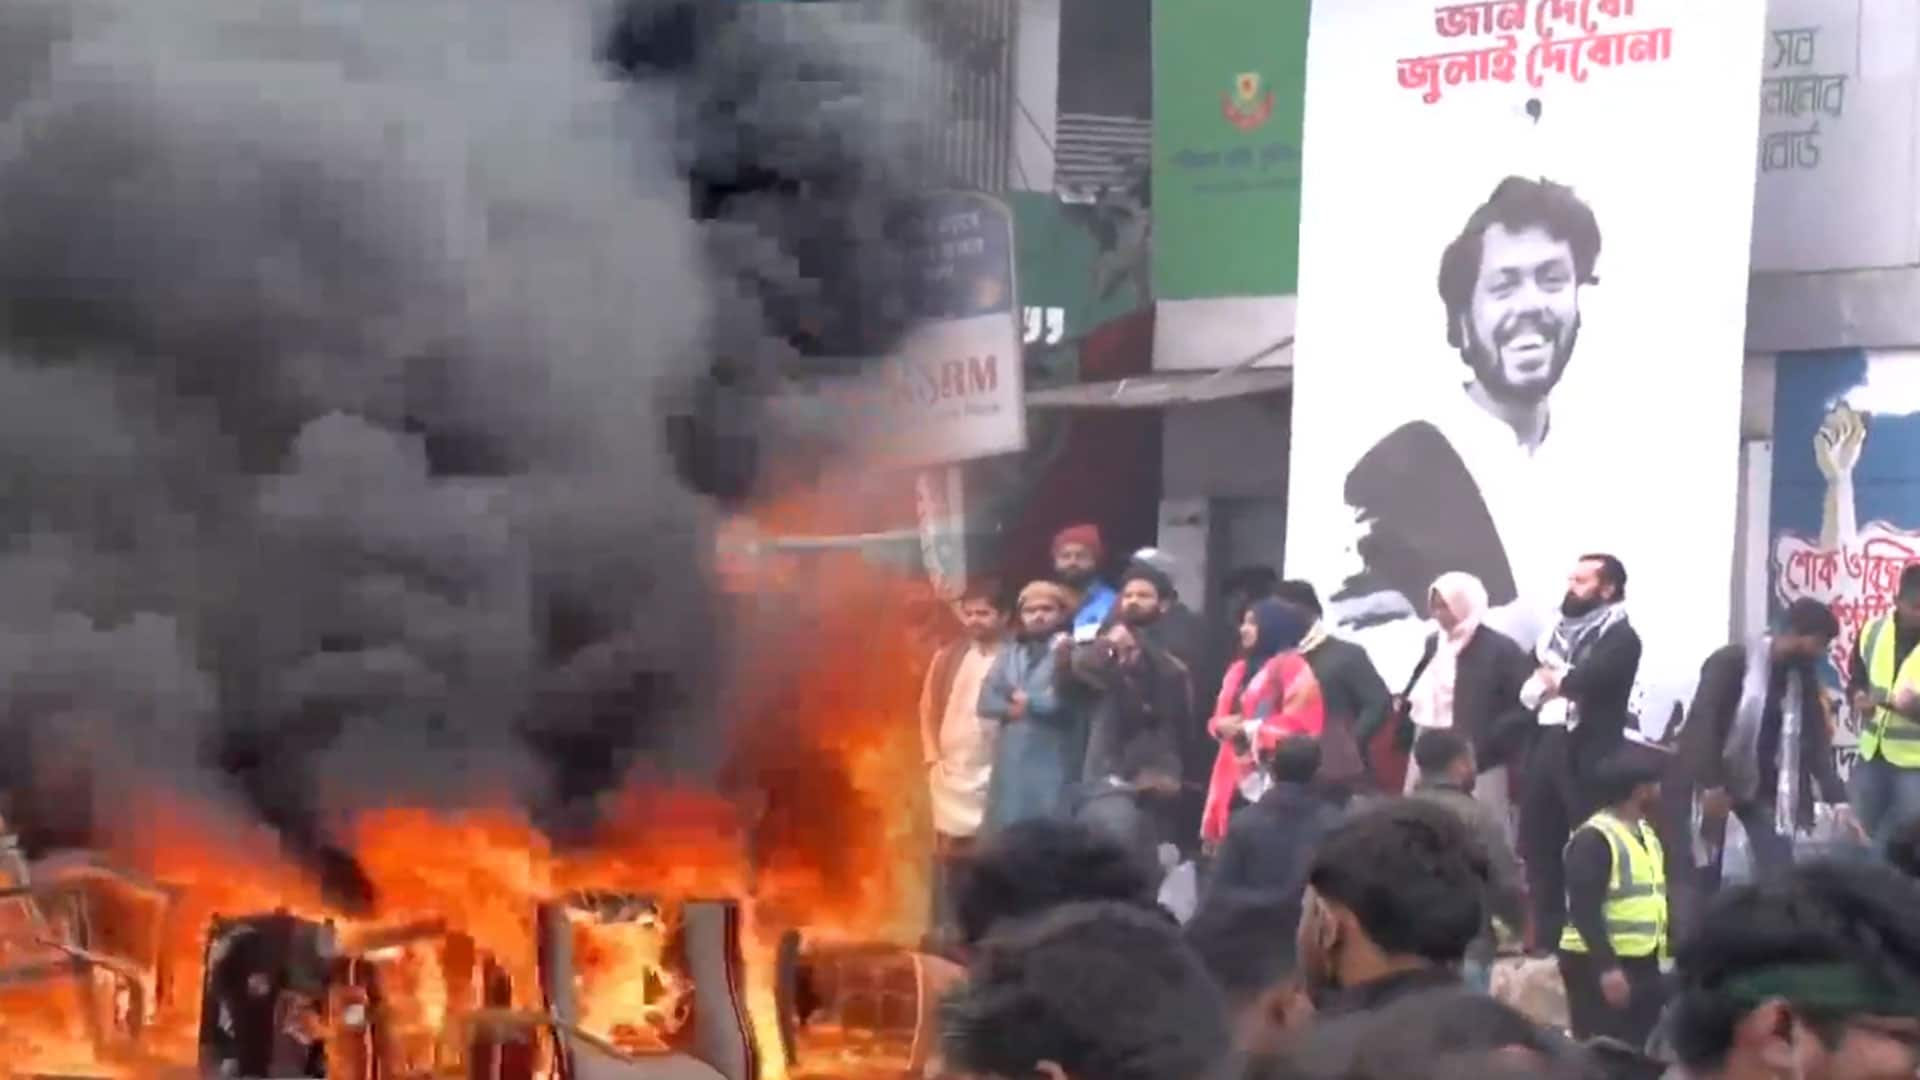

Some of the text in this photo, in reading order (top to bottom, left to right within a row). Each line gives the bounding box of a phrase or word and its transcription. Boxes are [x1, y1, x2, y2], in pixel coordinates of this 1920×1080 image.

[1434, 0, 1526, 37] জান
[1396, 35, 1518, 104] জুলাই
[1761, 120, 1821, 173] বোর্ড
[1786, 550, 1840, 591] শোক
[1842, 544, 1862, 579] ও
